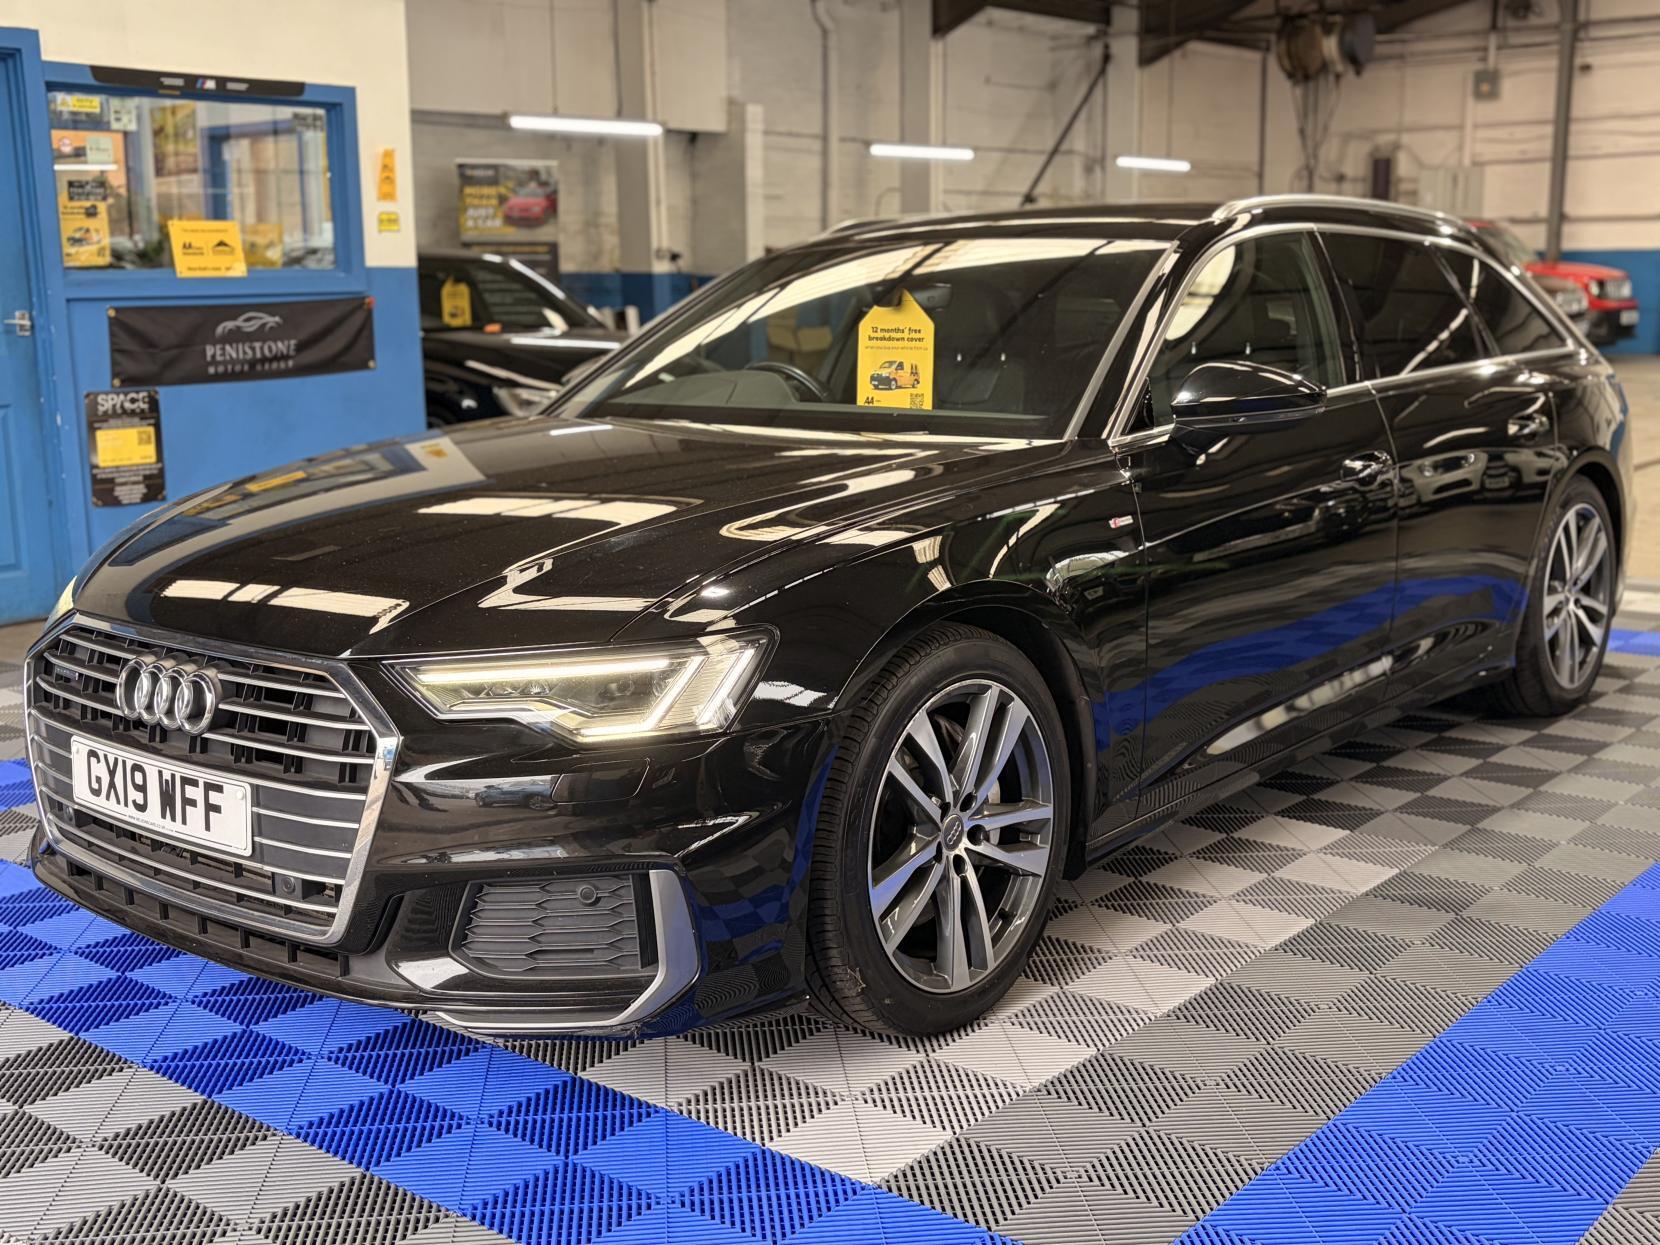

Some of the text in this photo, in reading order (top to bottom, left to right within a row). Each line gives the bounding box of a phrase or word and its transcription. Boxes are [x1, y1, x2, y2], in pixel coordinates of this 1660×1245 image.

[908, 327, 921, 335] free
[205, 339, 298, 362] PENISTONE
[97, 391, 149, 413] SPACE
[864, 396, 875, 406] AA
[86, 748, 225, 833] GX19 WFF
